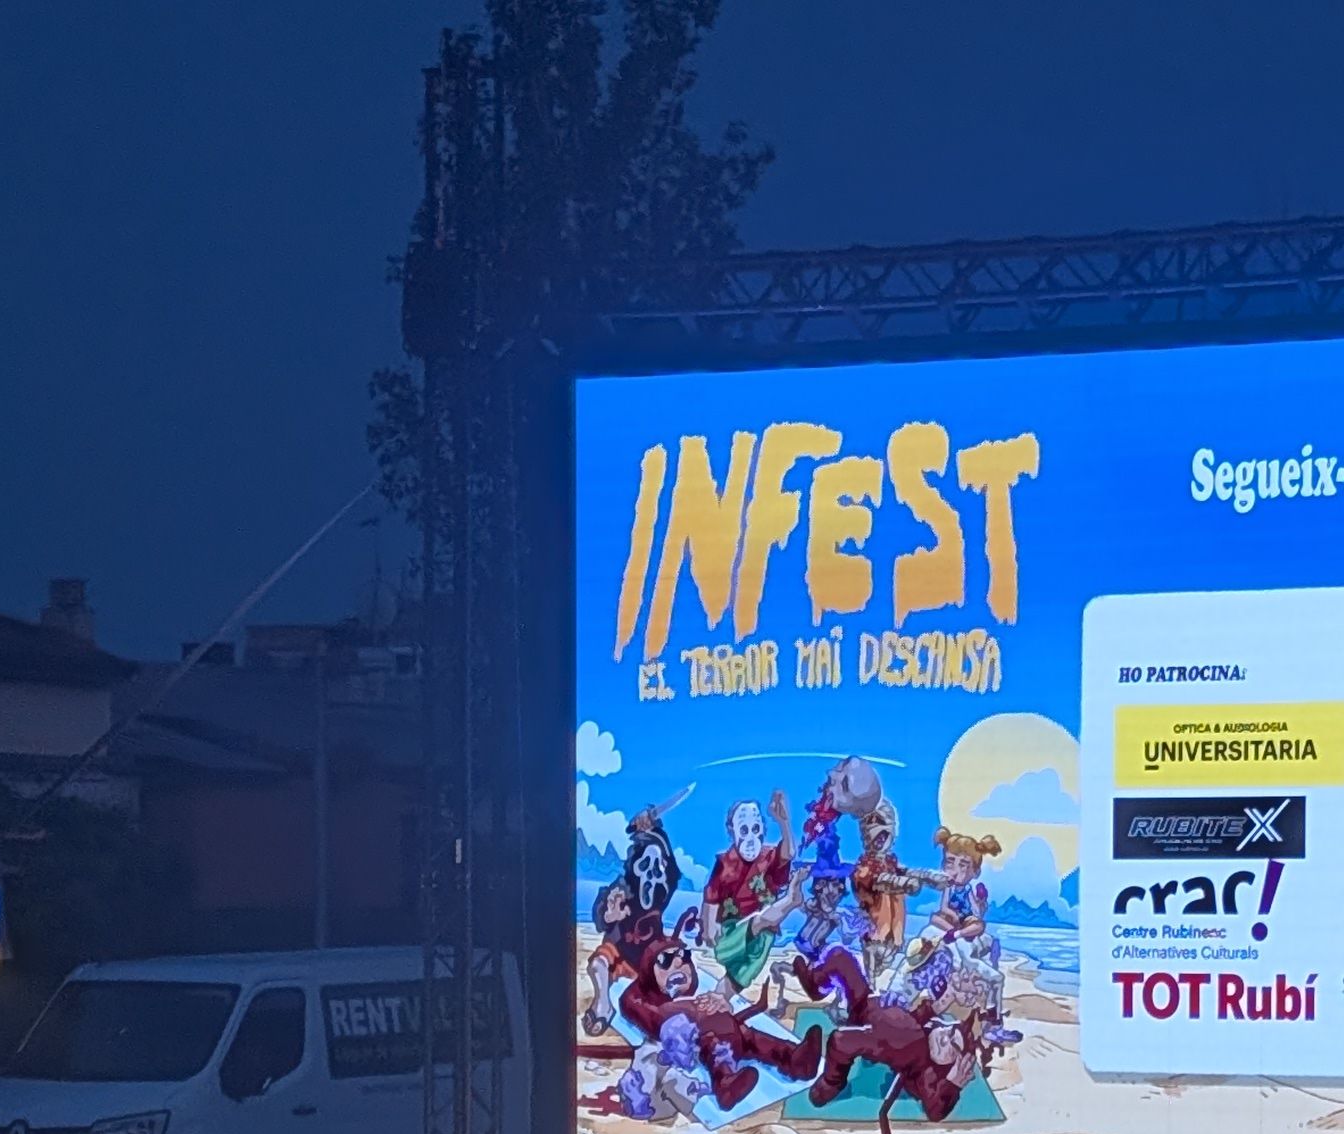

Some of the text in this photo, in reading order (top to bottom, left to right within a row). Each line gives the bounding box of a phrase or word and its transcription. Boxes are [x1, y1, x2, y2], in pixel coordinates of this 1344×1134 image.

[613, 421, 1040, 663] INFEST
[638, 661, 676, 702] EL
[680, 639, 779, 697] TERROR
[859, 629, 1002, 695] DESCANSA
[1118, 664, 1248, 683] HO PATROCINA:
[1143, 738, 1318, 763] UNIVERSITARIA
[1127, 798, 1291, 852] RUBITEX
[1111, 924, 1158, 939] Centre
[1111, 944, 1260, 960] d'Alternatives Culturals
[1111, 971, 1319, 1022] TOT Rubí
